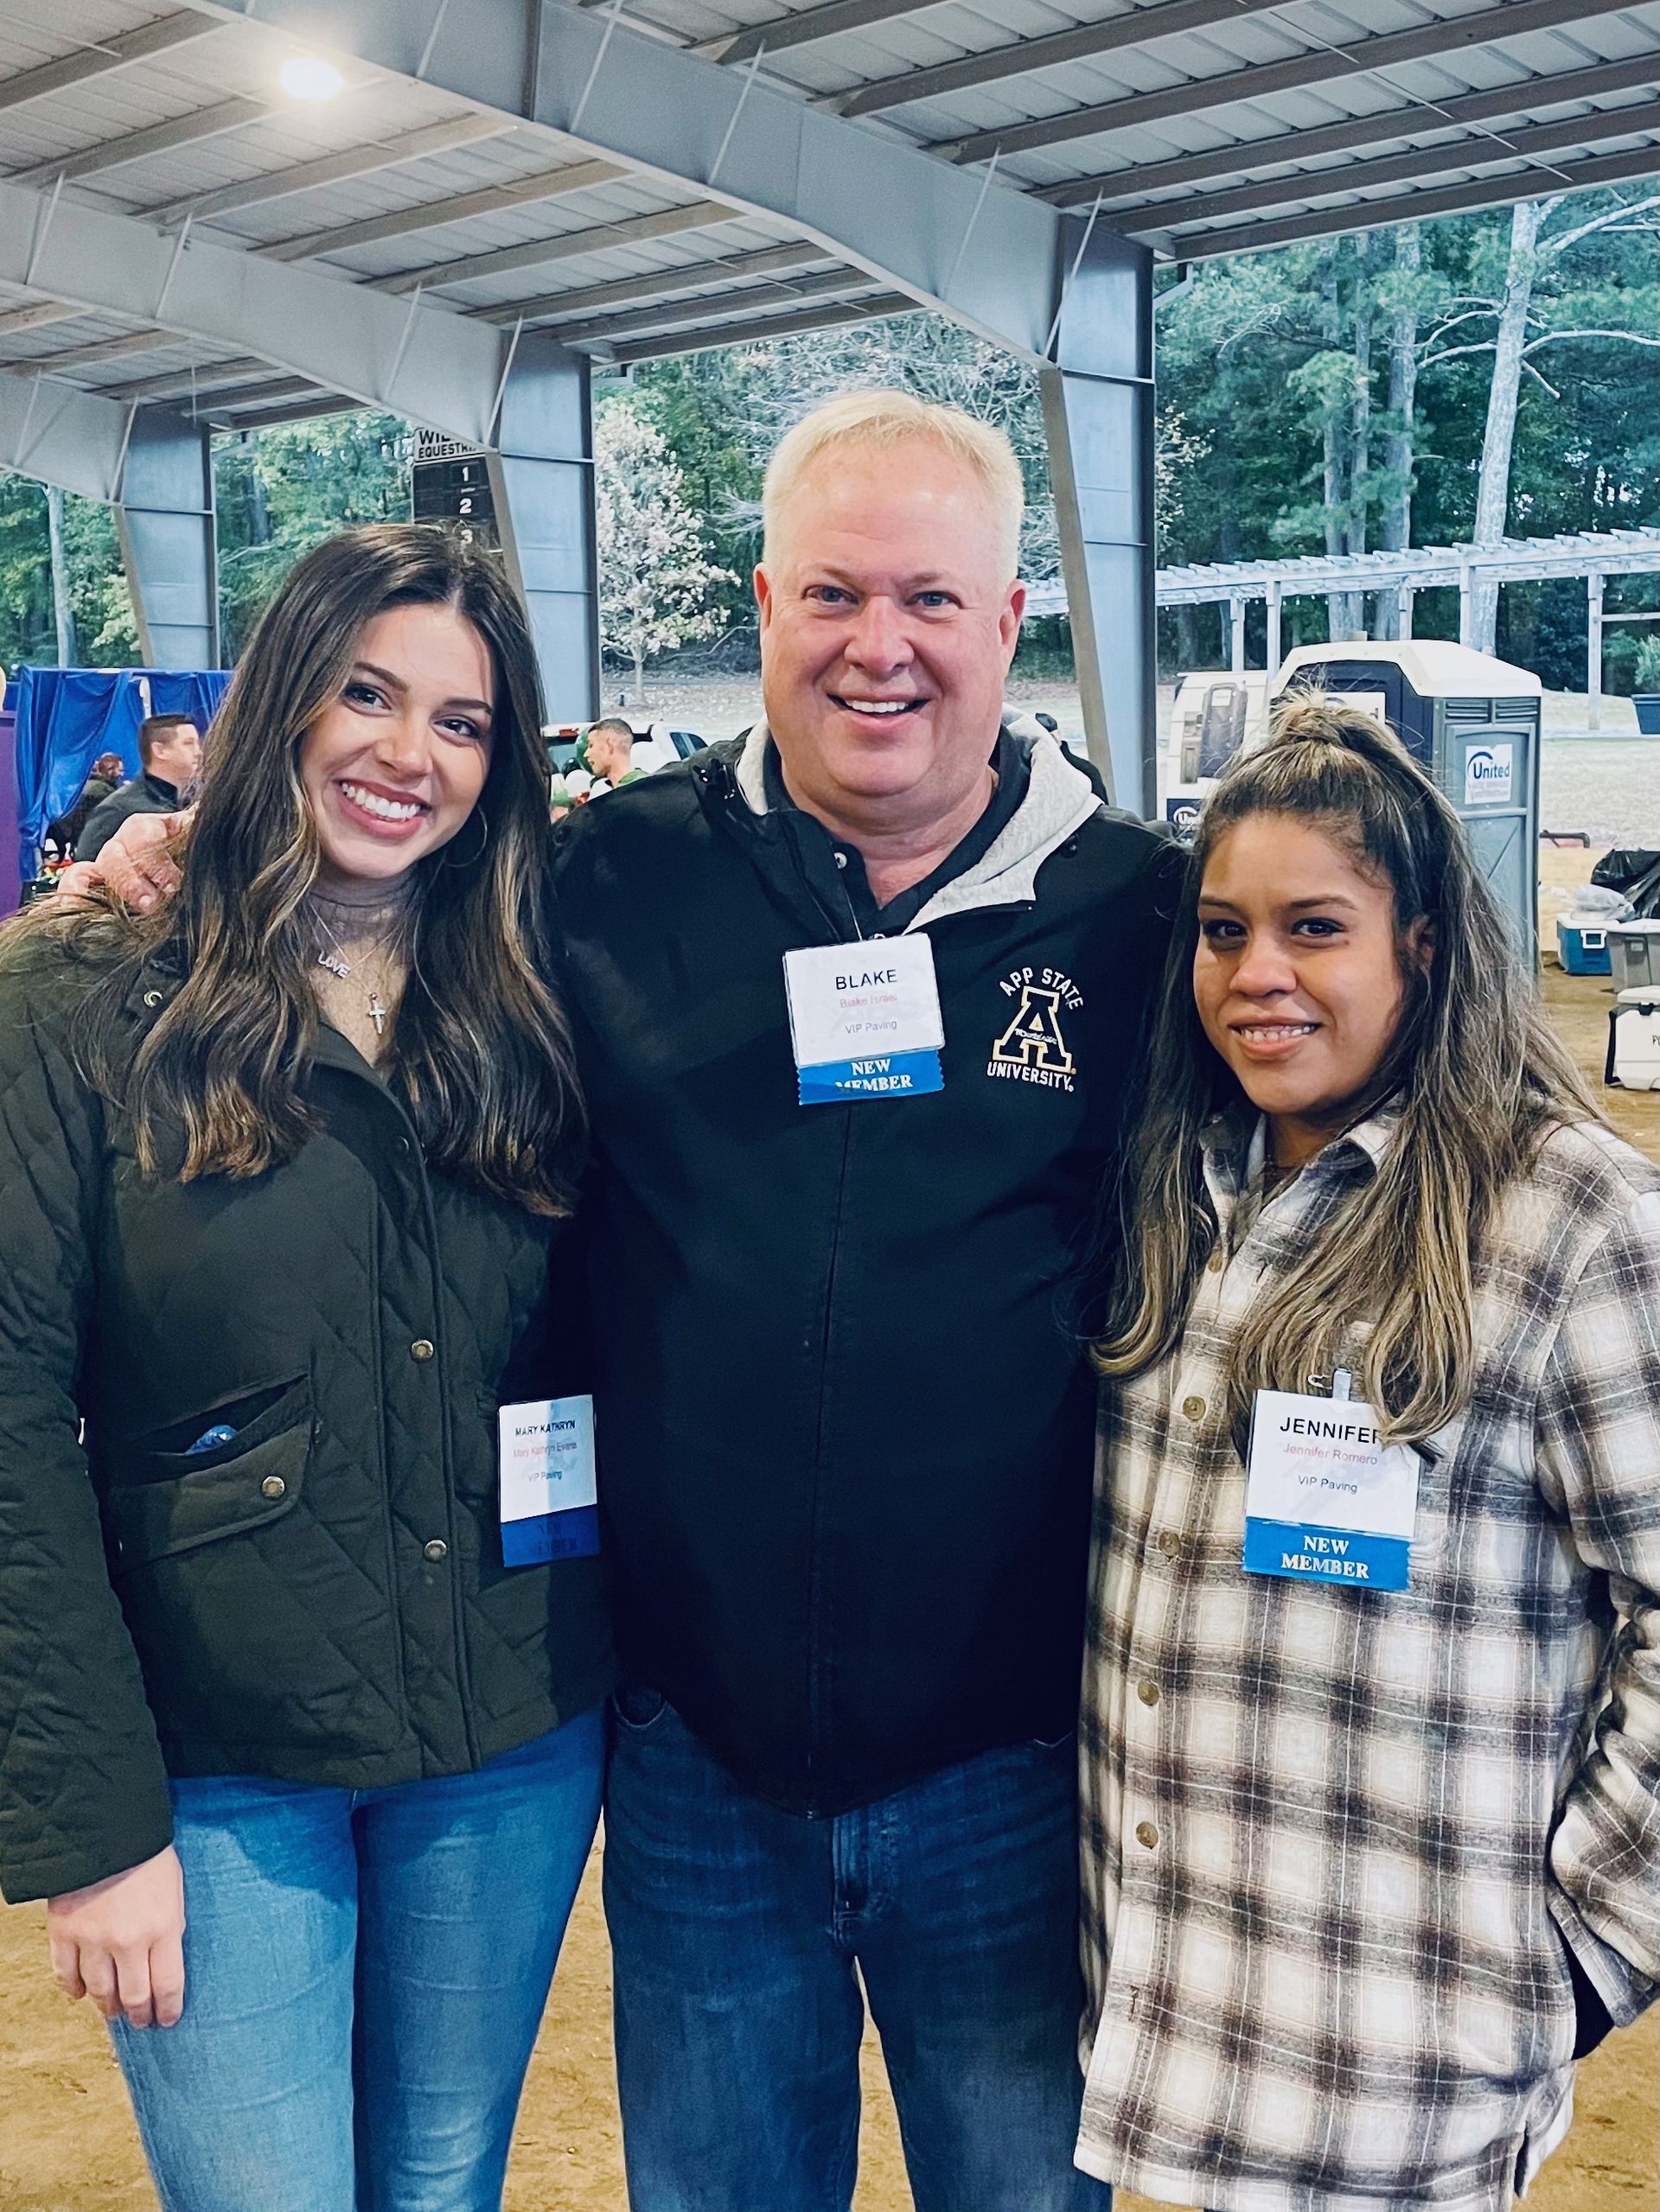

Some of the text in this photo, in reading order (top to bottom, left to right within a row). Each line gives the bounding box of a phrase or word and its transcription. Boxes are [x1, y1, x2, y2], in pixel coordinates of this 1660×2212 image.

[462, 466, 469, 481] 1
[459, 498, 472, 513] 2
[461, 529, 473, 545] 3
[1473, 761, 1510, 780] United
[835, 969, 897, 990] BLAKE
[999, 966, 1083, 1010] APP STATE
[845, 1020, 897, 1035] VIP Paving
[851, 1058, 891, 1076] NEW
[515, 1419, 576, 1436] MARY KATHRYN
[1283, 1444, 1377, 1465] Jennifer Romero
[1298, 1475, 1357, 1495] VIP Paving
[1303, 1535, 1350, 1555] NEW
[1280, 1553, 1370, 1579] MEMBER
